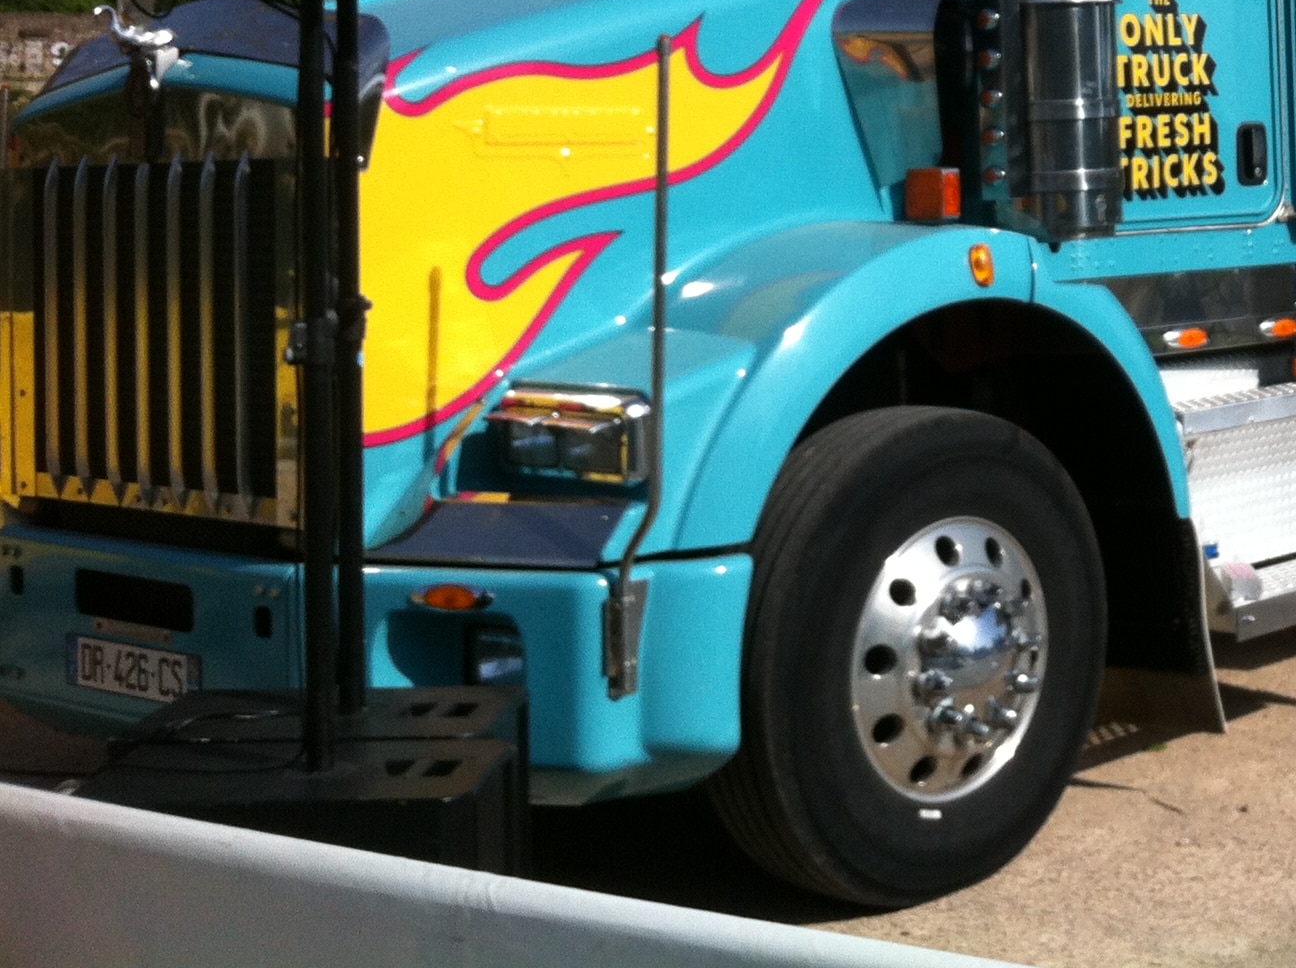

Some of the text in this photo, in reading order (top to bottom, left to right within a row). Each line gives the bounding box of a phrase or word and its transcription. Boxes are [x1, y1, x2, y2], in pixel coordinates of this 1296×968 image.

[1120, 13, 1199, 48] ONLY
[1116, 53, 1211, 87] TRUCK
[1126, 92, 1202, 109] DELIVERING
[1118, 113, 1212, 149] FRESH
[1120, 151, 1220, 190] RICKS
